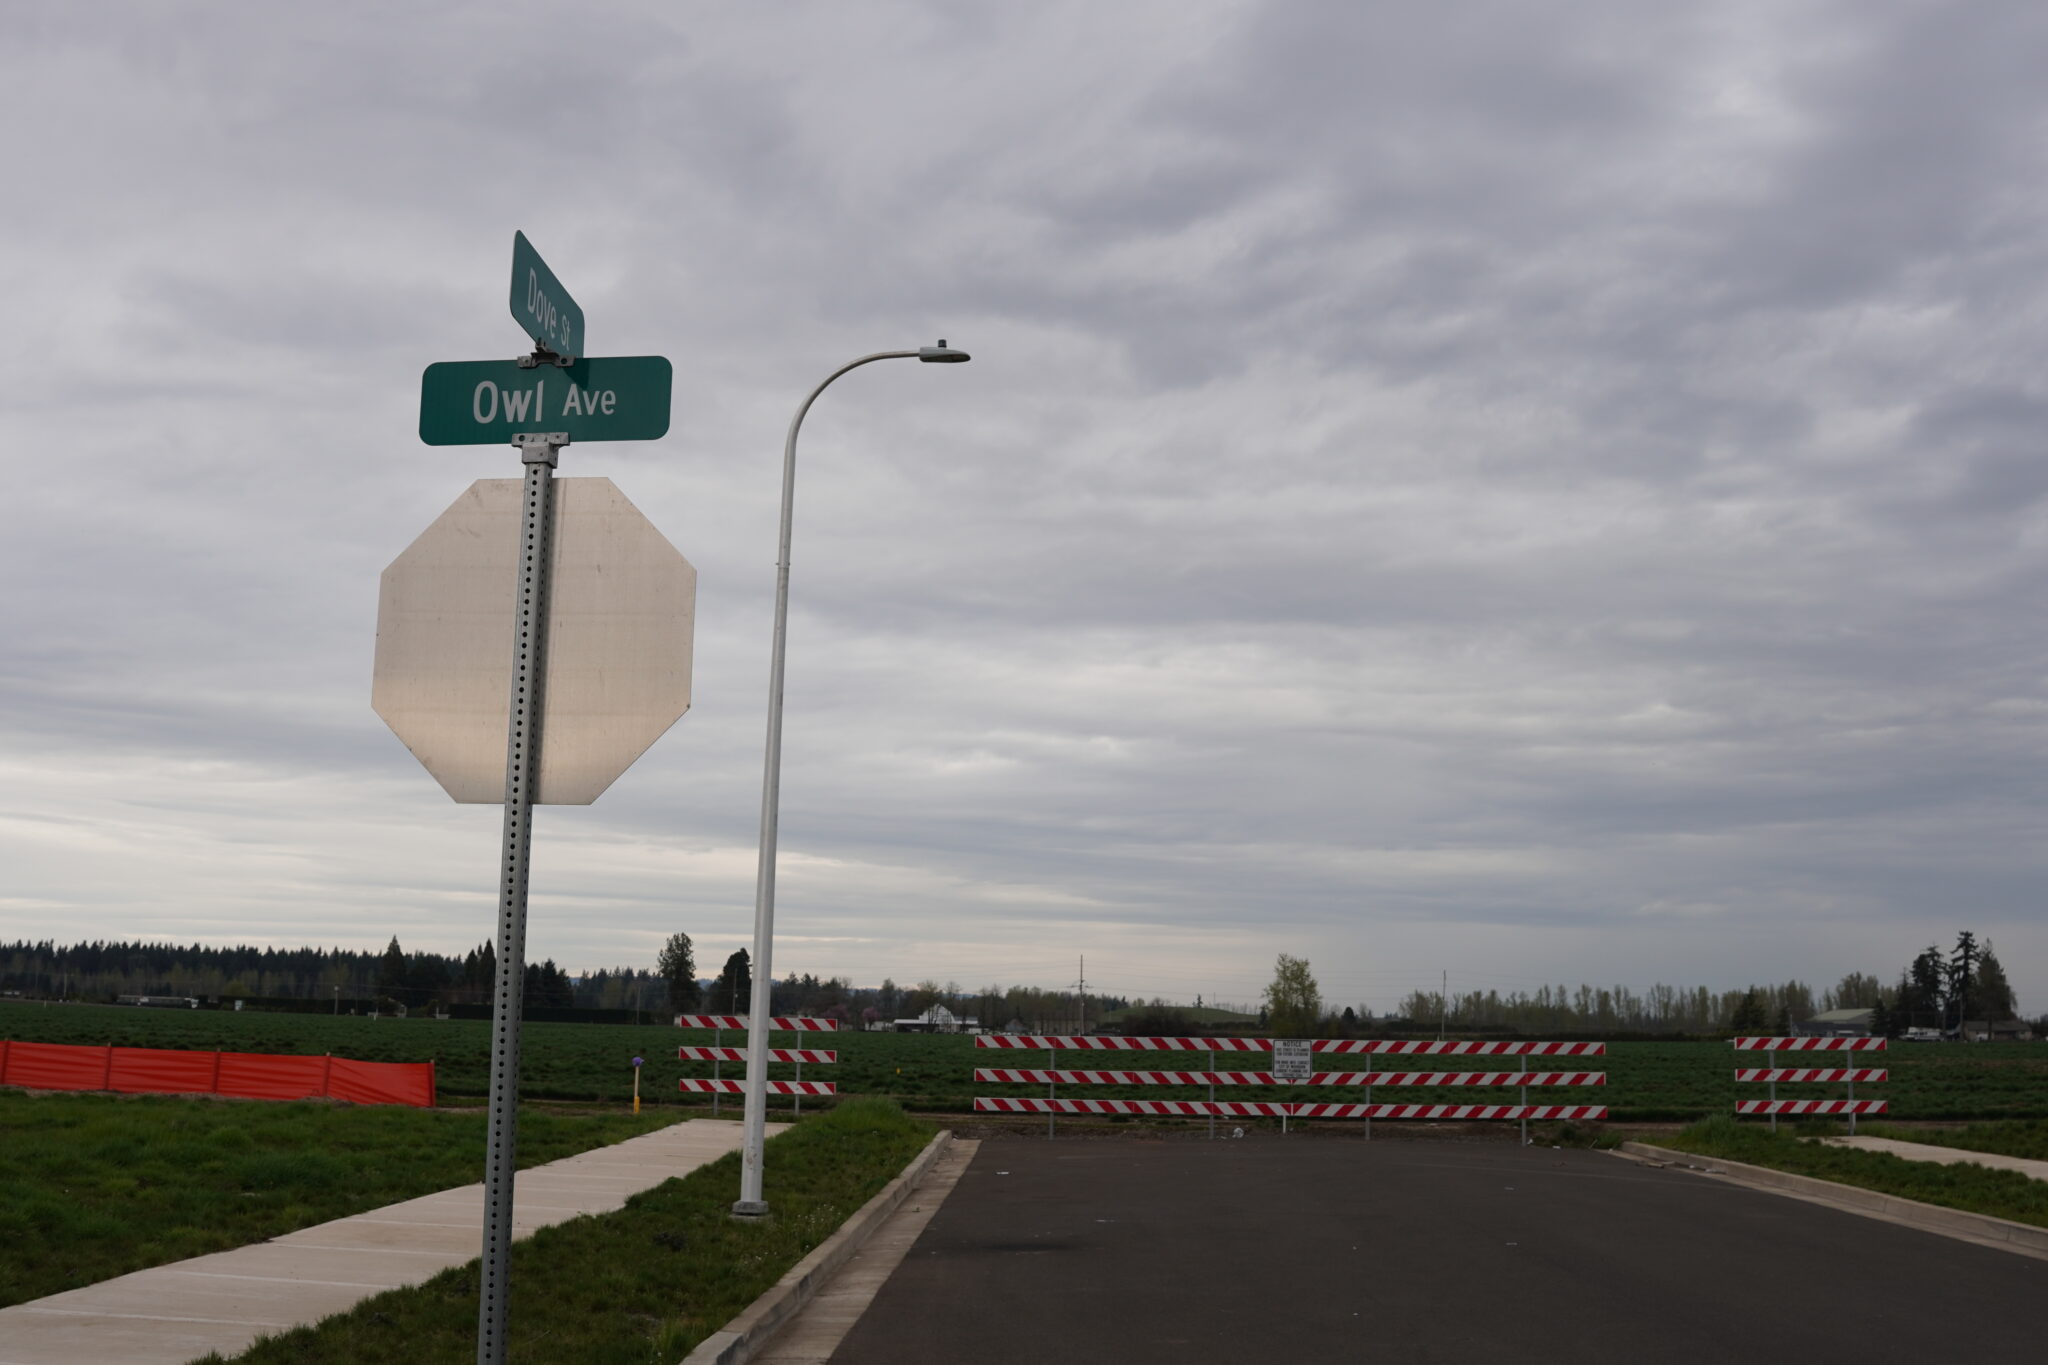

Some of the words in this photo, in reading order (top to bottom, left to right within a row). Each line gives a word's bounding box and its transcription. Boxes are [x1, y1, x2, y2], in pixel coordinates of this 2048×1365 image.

[527, 267, 557, 338] Dove
[561, 314, 570, 351] St
[473, 380, 544, 424] Owl
[562, 383, 616, 416] Ave
